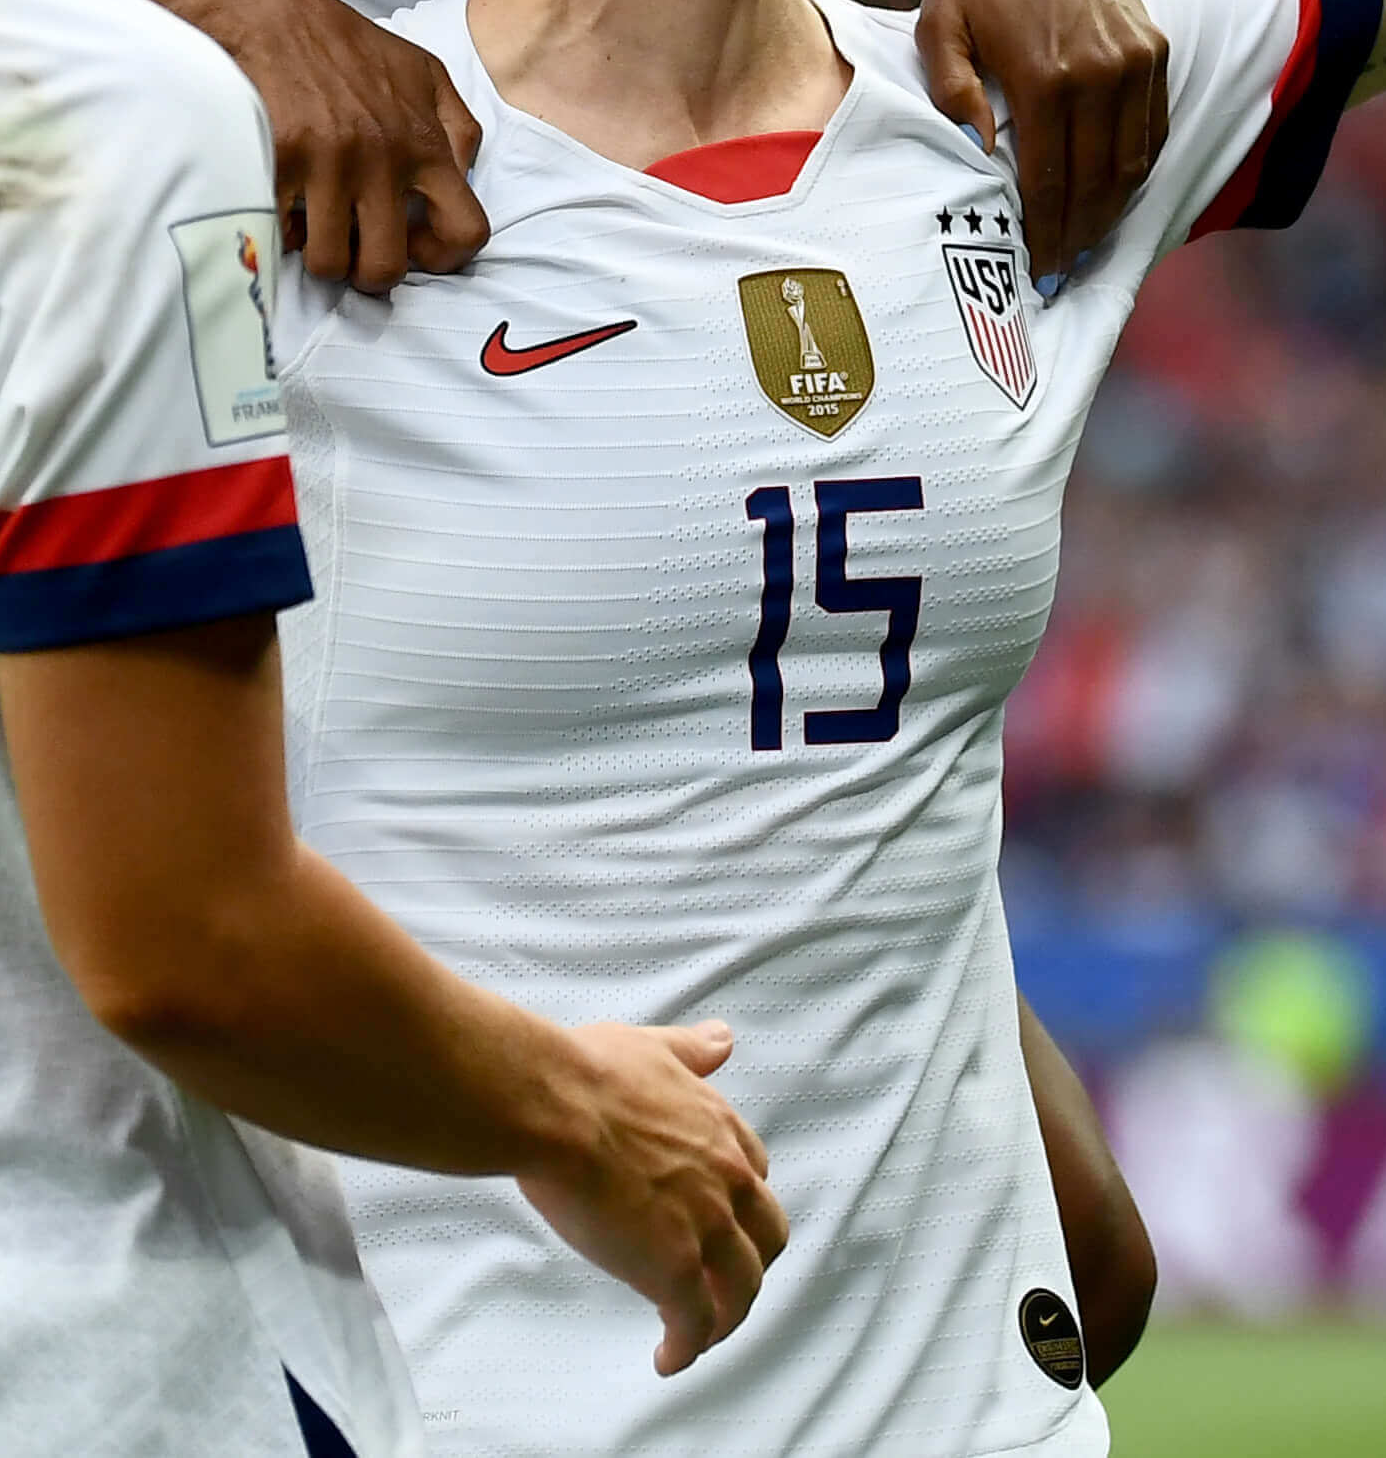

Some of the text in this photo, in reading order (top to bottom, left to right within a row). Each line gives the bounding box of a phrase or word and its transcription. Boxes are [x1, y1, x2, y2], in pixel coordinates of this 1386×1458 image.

[952, 256, 1016, 316] USA
[807, 403, 840, 417] 2015
[745, 475, 925, 752] 15
